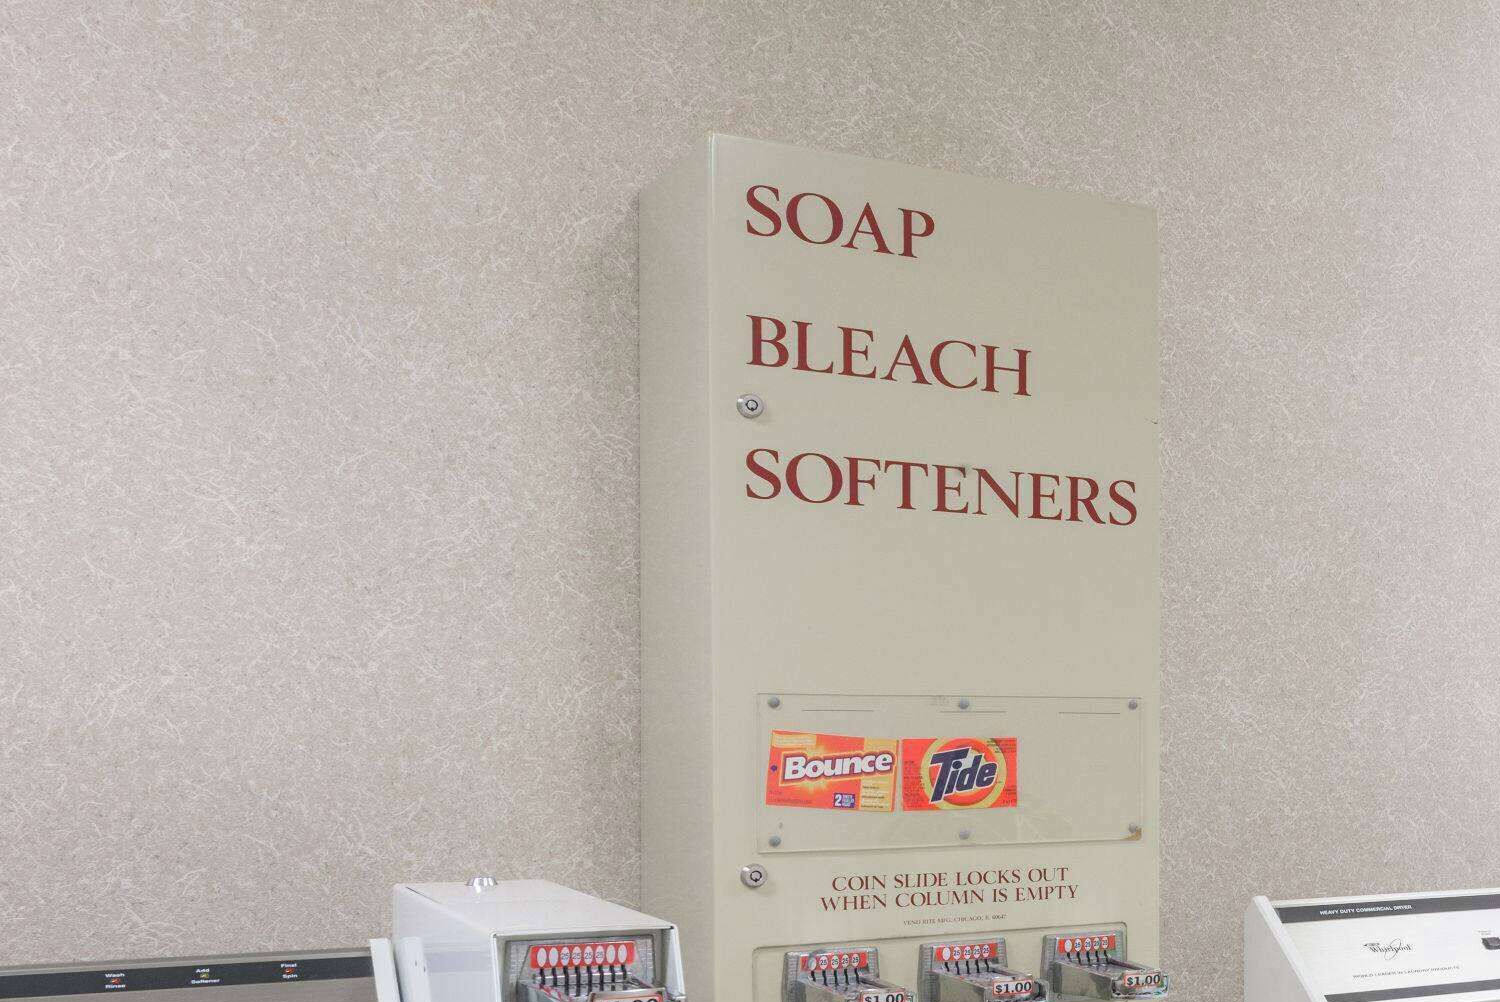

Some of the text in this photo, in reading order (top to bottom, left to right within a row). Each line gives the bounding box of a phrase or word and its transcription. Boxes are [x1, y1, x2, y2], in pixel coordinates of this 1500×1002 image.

[746, 185, 935, 258] SOAP
[746, 315, 1031, 397] BLEACH
[745, 448, 1138, 526] SOFTENERS
[784, 753, 893, 780] Bounce
[929, 747, 998, 804] Tide
[832, 866, 1069, 891] COIN SLIDE LOCKS OUT
[820, 884, 1079, 912] WHEN COLUMN IS EMPTY
[1368, 938, 1414, 961] Whirlpool
[995, 981, 1032, 994] $1.00
[1126, 973, 1161, 987] $1.00
